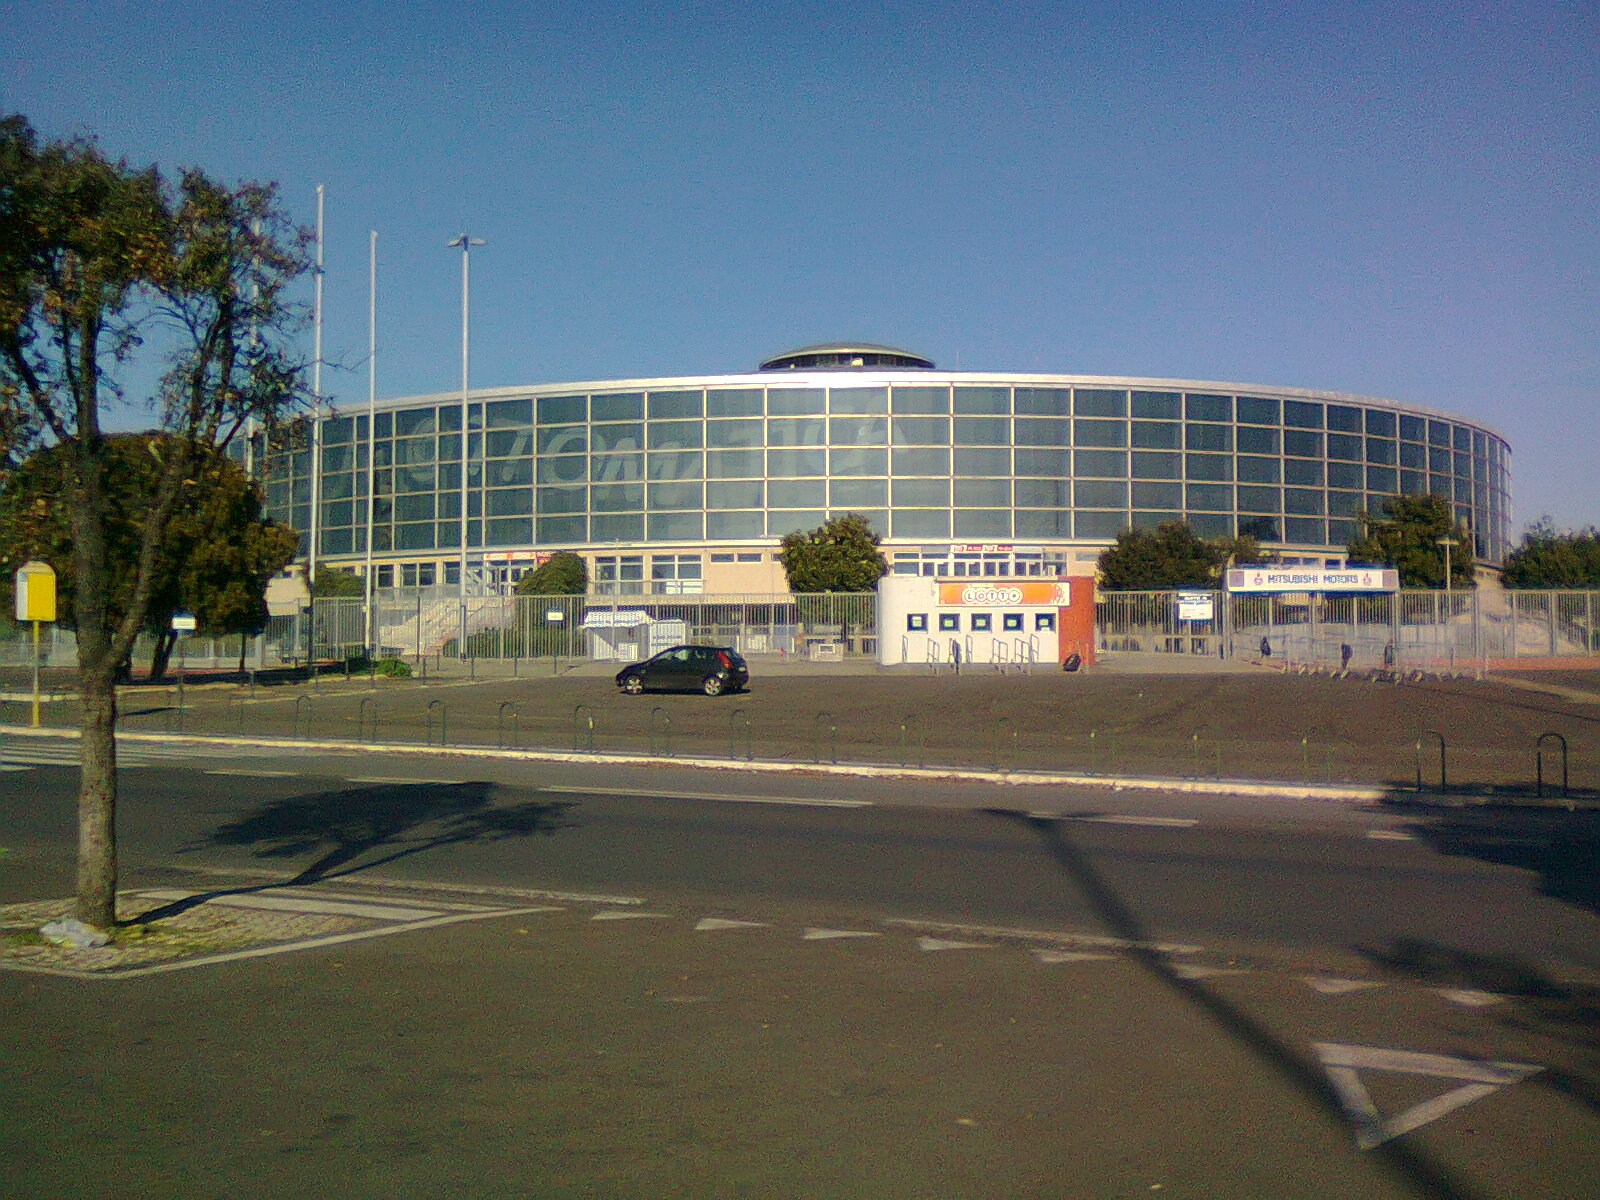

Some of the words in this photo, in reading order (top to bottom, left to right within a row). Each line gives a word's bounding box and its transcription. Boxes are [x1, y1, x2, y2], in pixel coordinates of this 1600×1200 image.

[1267, 574, 1319, 584] MITSUBISHI
[1323, 574, 1359, 584] MOTORS
[964, 589, 1021, 603] LOTTO
